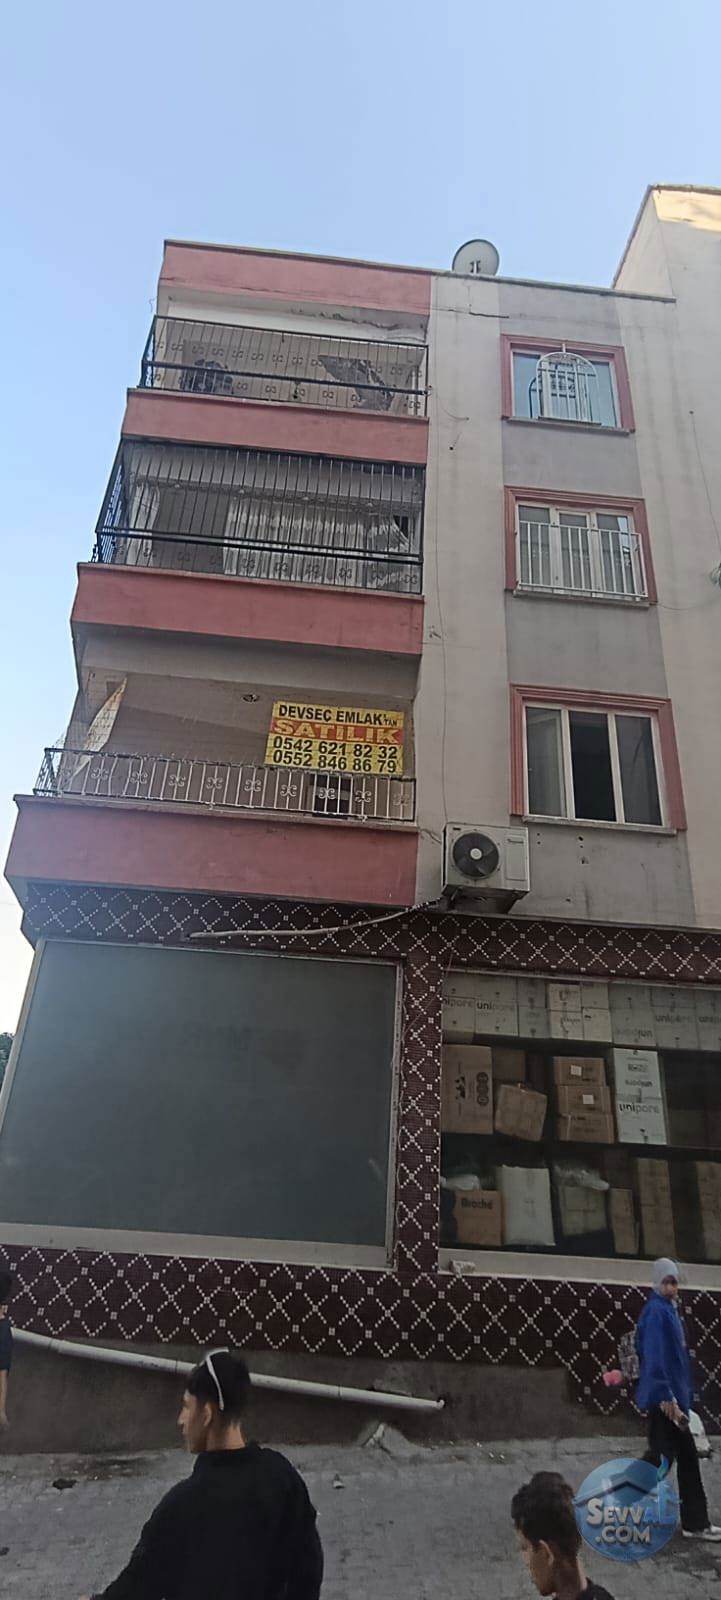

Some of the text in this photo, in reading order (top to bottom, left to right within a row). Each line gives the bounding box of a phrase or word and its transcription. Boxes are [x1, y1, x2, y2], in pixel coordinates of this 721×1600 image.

[279, 704, 332, 722] DEVSEÇ
[274, 719, 400, 744] SATILIK
[273, 736, 398, 759] 0542 621 82 32
[273, 749, 397, 773] 0552 846 86 79
